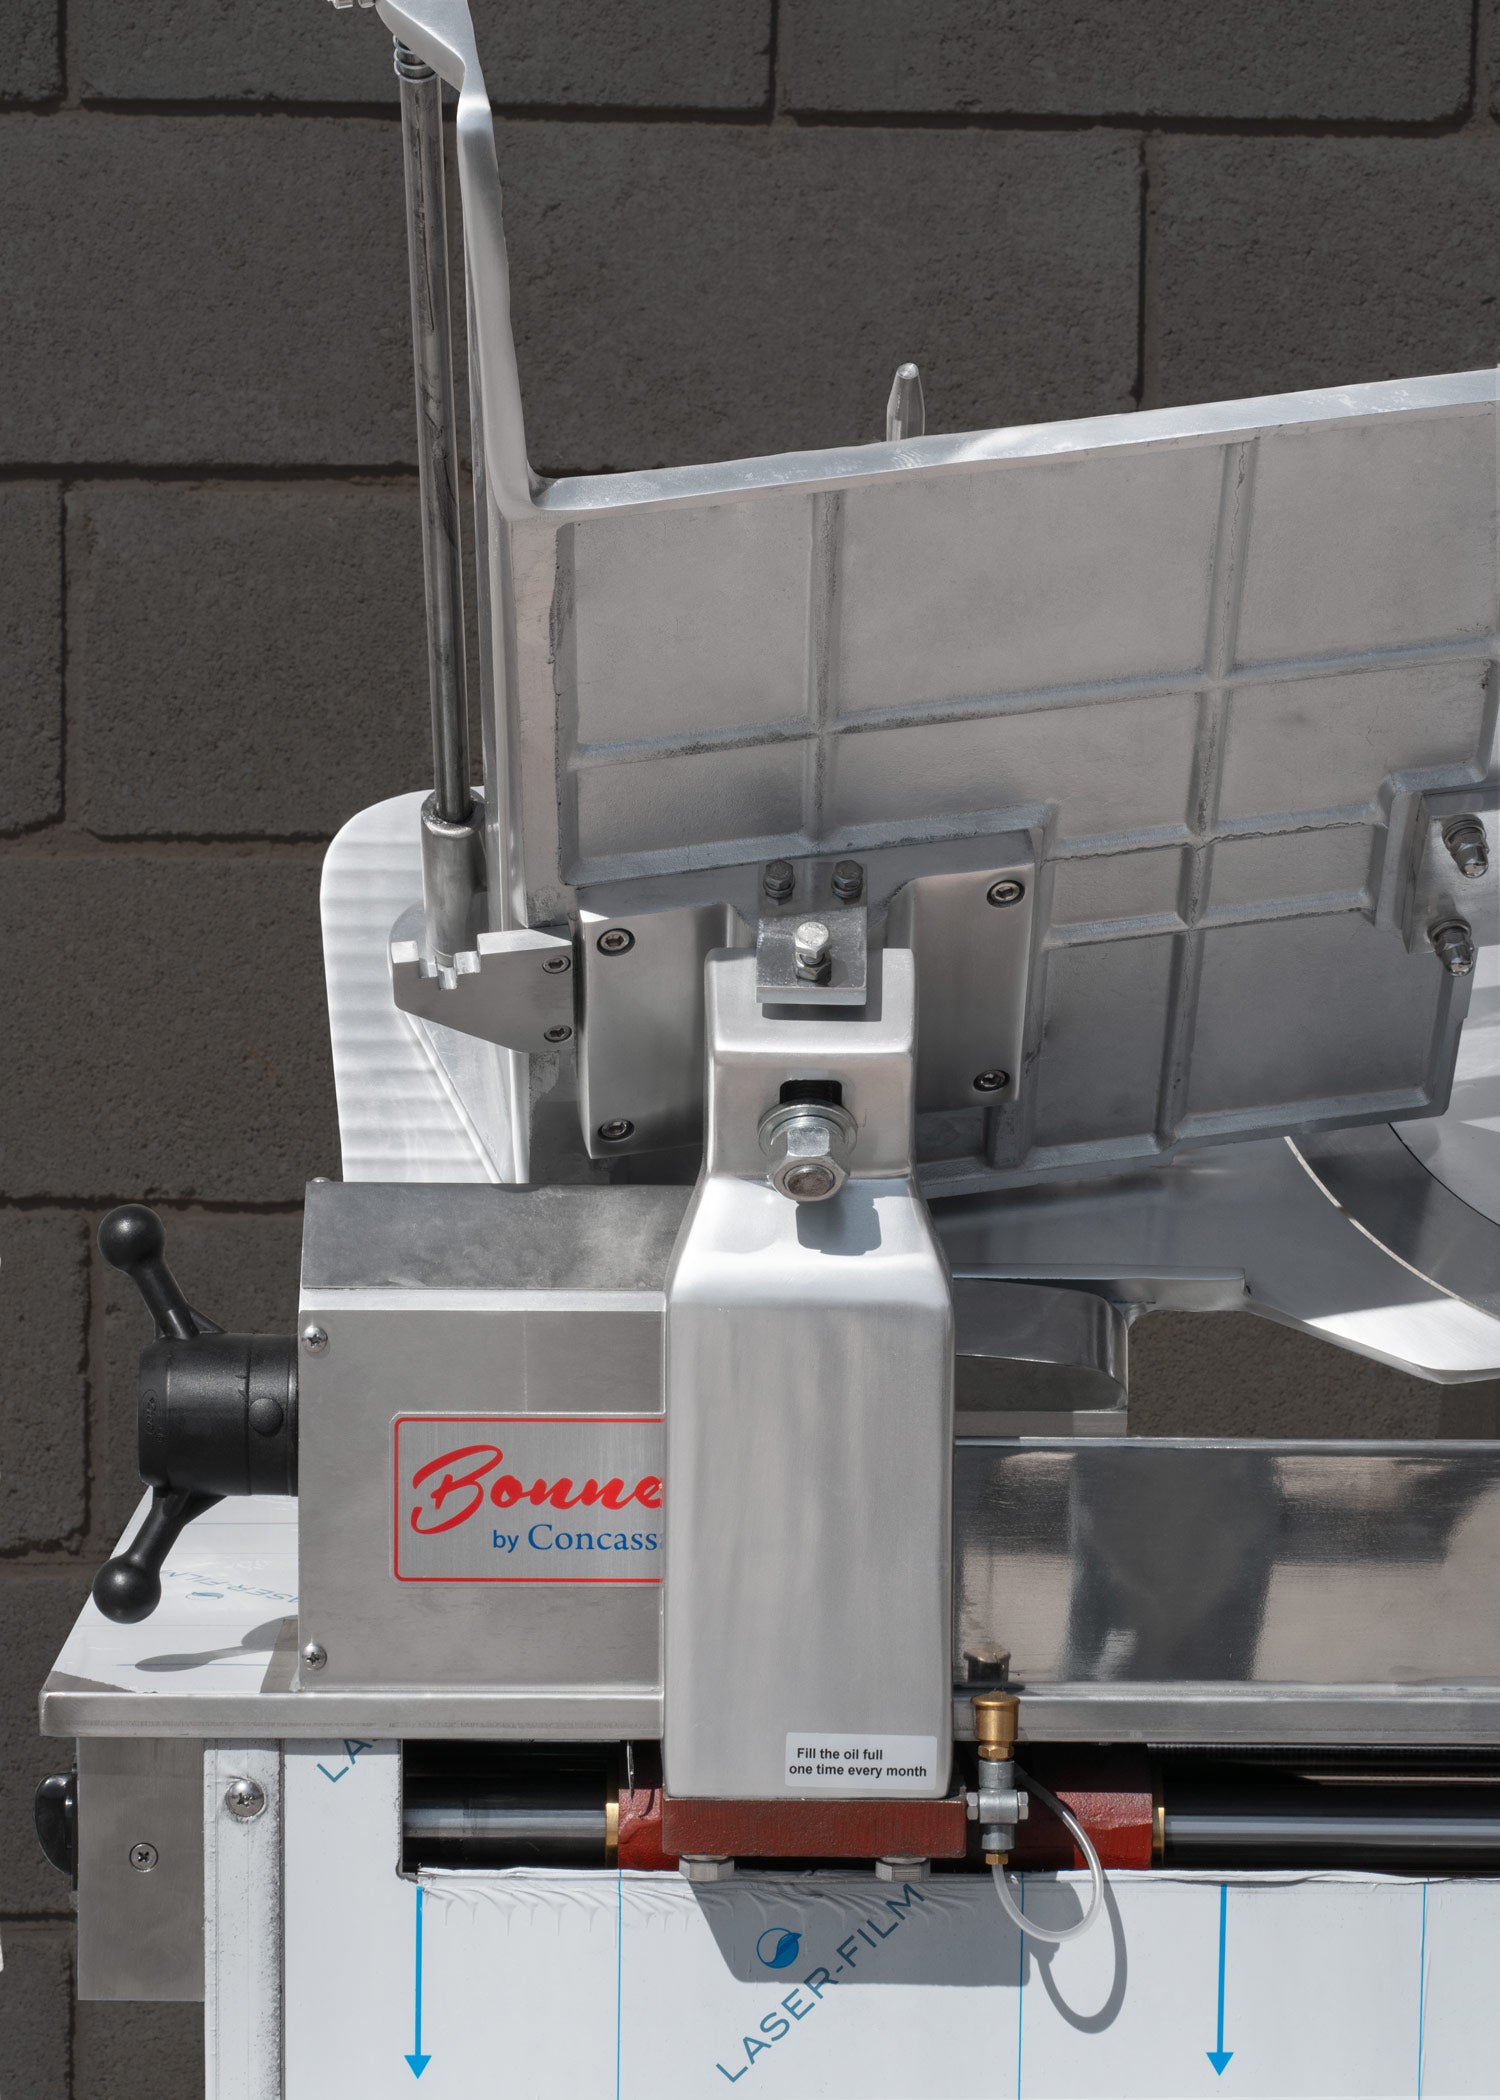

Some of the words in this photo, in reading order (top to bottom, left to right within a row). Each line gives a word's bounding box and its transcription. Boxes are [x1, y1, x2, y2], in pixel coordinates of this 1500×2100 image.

[492, 1529, 519, 1553] by
[316, 1738, 379, 1783] LA
[797, 1747, 816, 1759] Fill
[820, 1748, 840, 1760] the
[844, 1748, 859, 1760] oil
[863, 1749, 883, 1760] full
[789, 1764, 813, 1775] one
[816, 1764, 844, 1775] time
[847, 1766, 883, 1779] every
[886, 1766, 927, 1777] month
[715, 1883, 926, 2084] LASER-FILM
